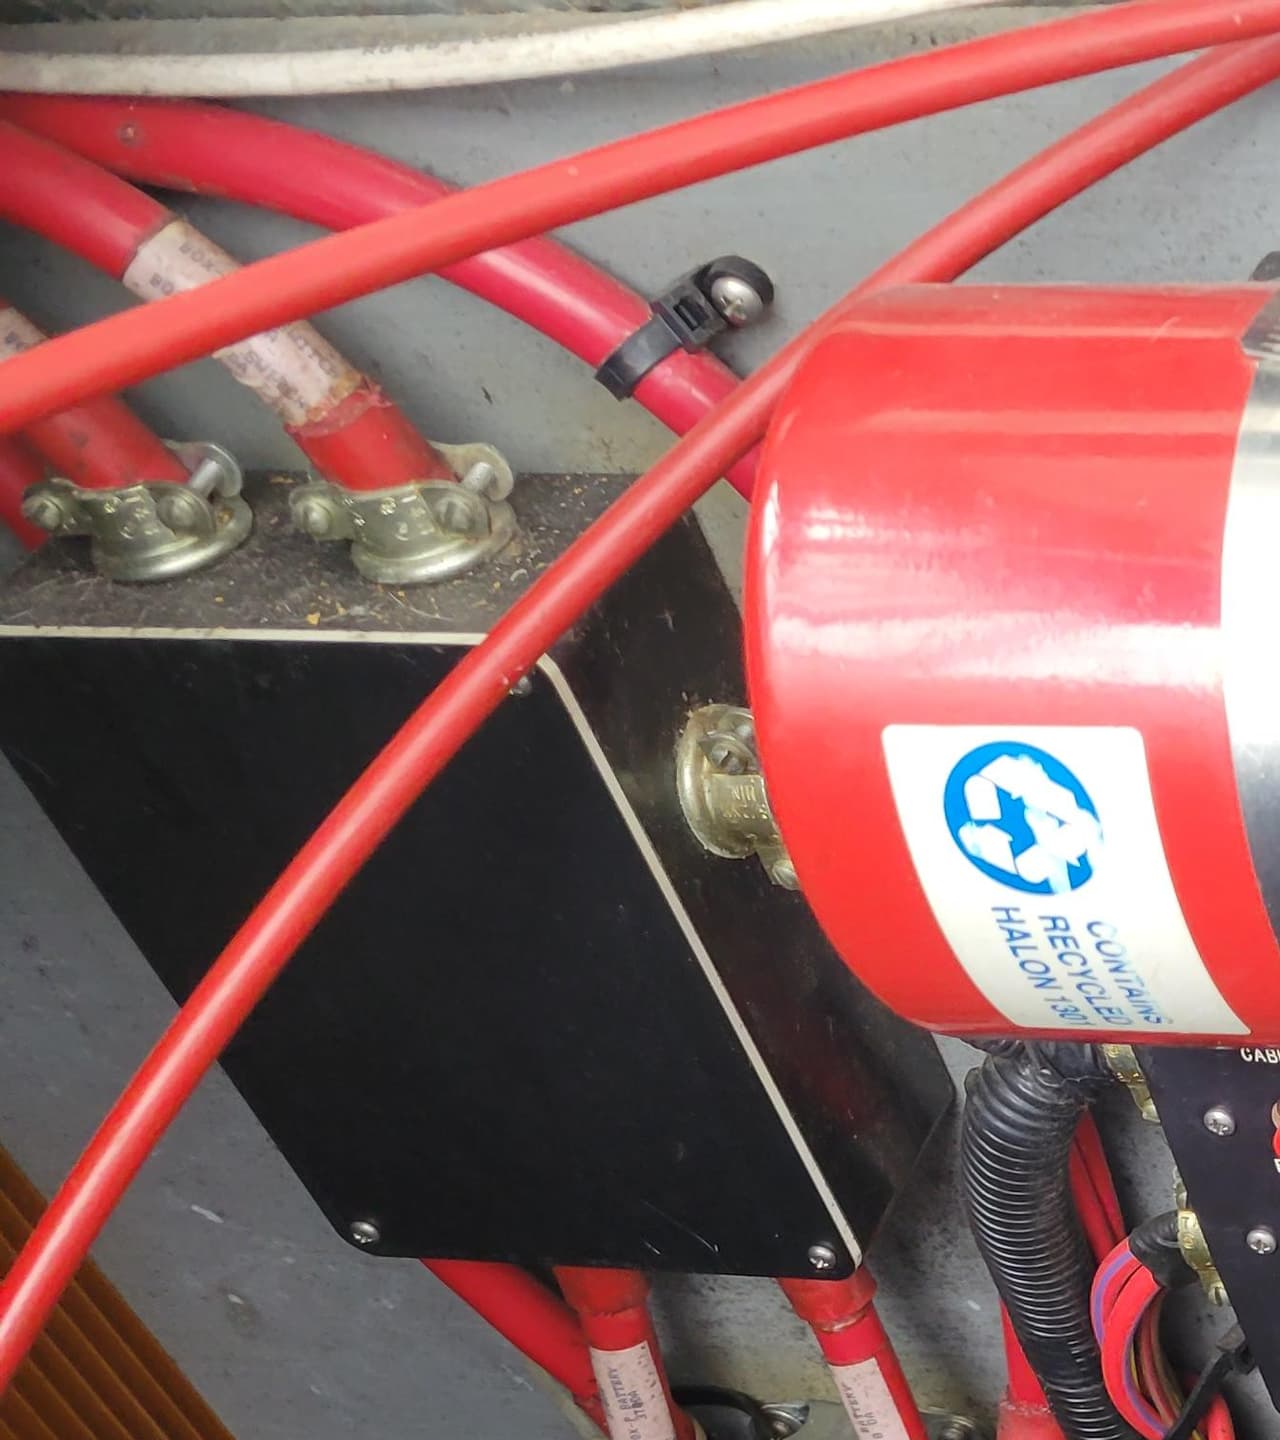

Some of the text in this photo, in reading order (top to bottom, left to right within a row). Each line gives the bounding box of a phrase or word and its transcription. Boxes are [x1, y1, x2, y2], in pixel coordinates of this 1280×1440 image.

[991, 907, 1062, 990] HALON
[1037, 914, 1133, 1027] RECYCLED
[1086, 920, 1174, 1025] CONTAINS
